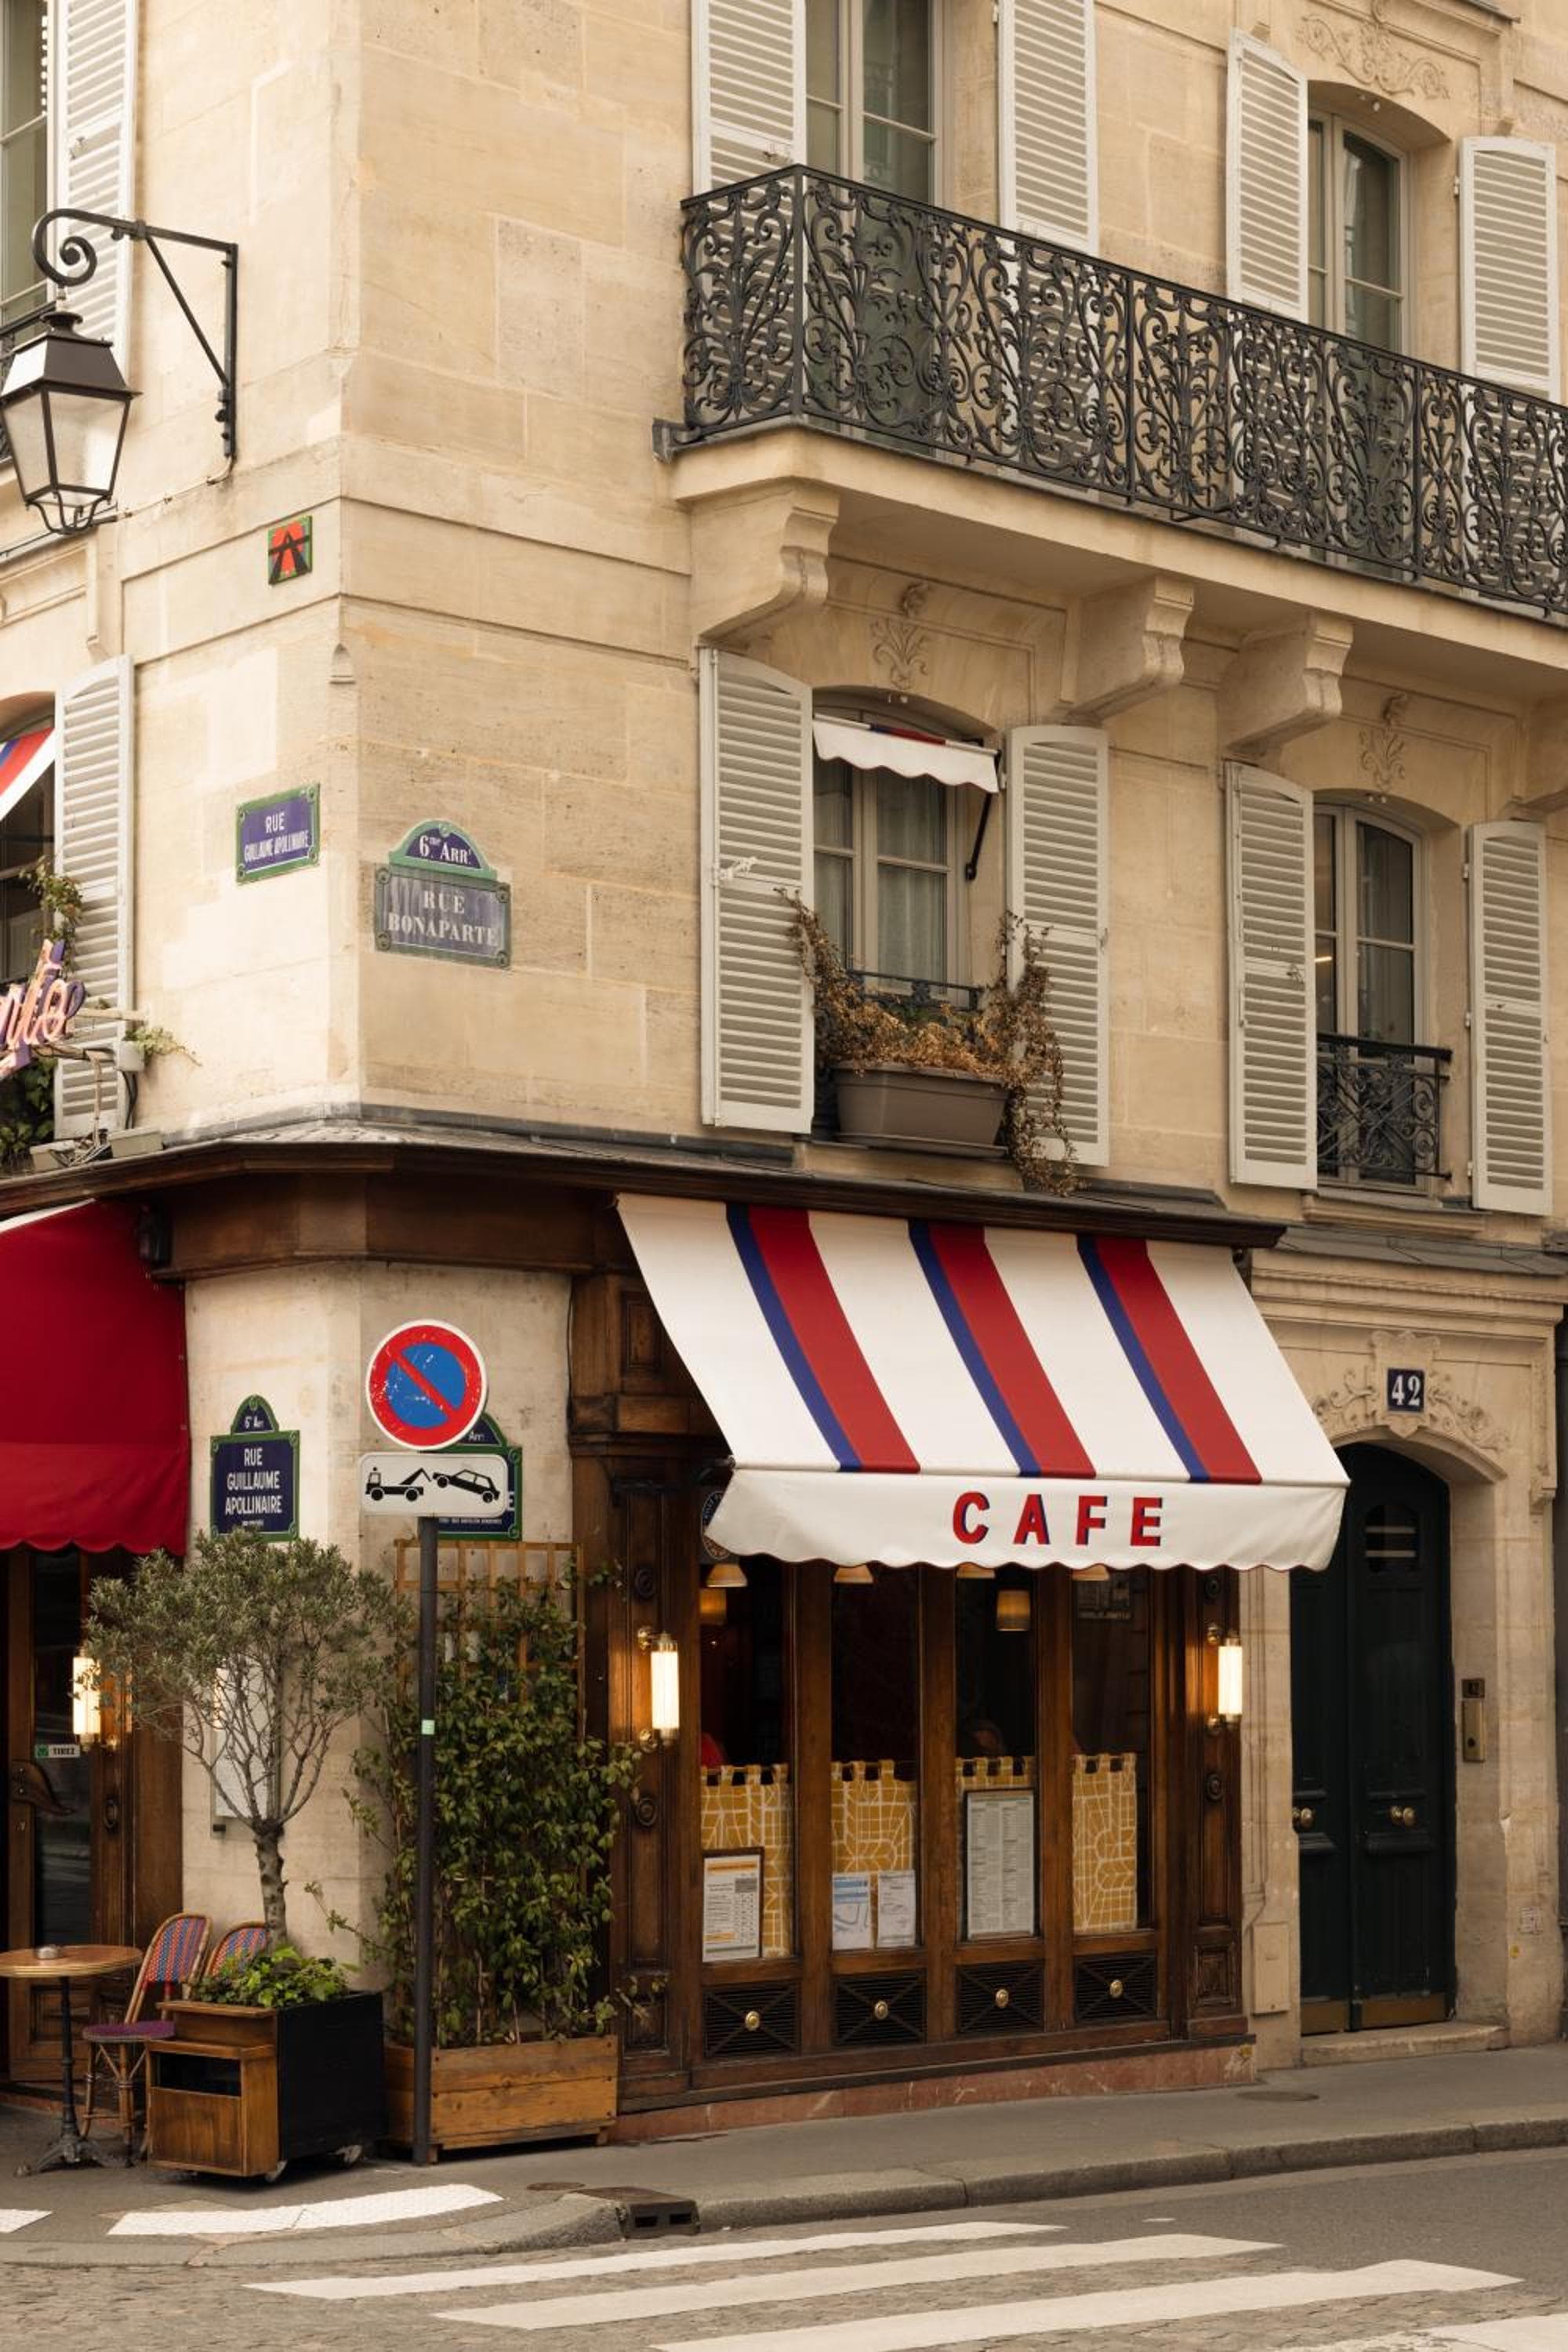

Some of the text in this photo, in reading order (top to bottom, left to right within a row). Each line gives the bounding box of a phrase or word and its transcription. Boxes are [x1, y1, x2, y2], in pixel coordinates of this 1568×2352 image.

[266, 812, 285, 833] RUE
[423, 891, 465, 914] RUE
[388, 913, 499, 947] BONAPARTE
[1392, 1375, 1421, 1405] 42
[244, 1448, 263, 1466] RUE
[227, 1471, 281, 1490] GUILLAUME
[225, 1495, 282, 1515] APOLLINAIRE
[953, 1491, 1163, 1546] CAFE
